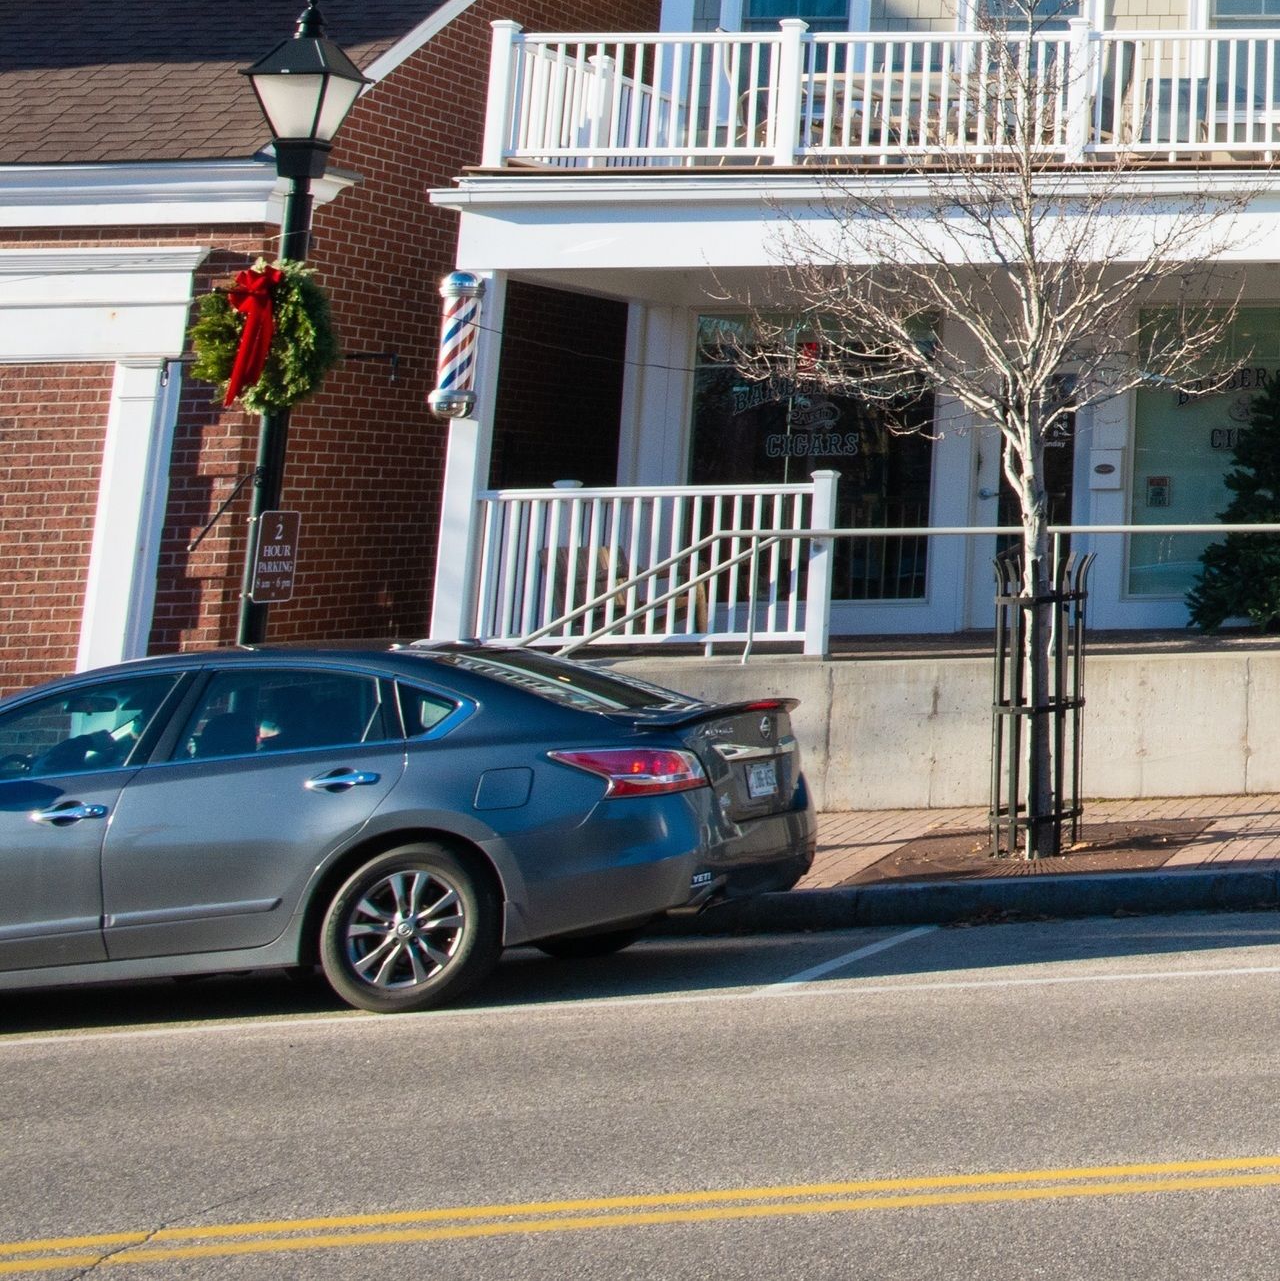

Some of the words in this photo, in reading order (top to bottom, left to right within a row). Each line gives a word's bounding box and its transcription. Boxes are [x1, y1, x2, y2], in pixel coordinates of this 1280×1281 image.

[766, 433, 859, 457] CIGARS
[275, 524, 284, 540] 2
[264, 546, 291, 556] HOUR
[258, 562, 293, 572] PARKING
[693, 873, 711, 883] YETI
